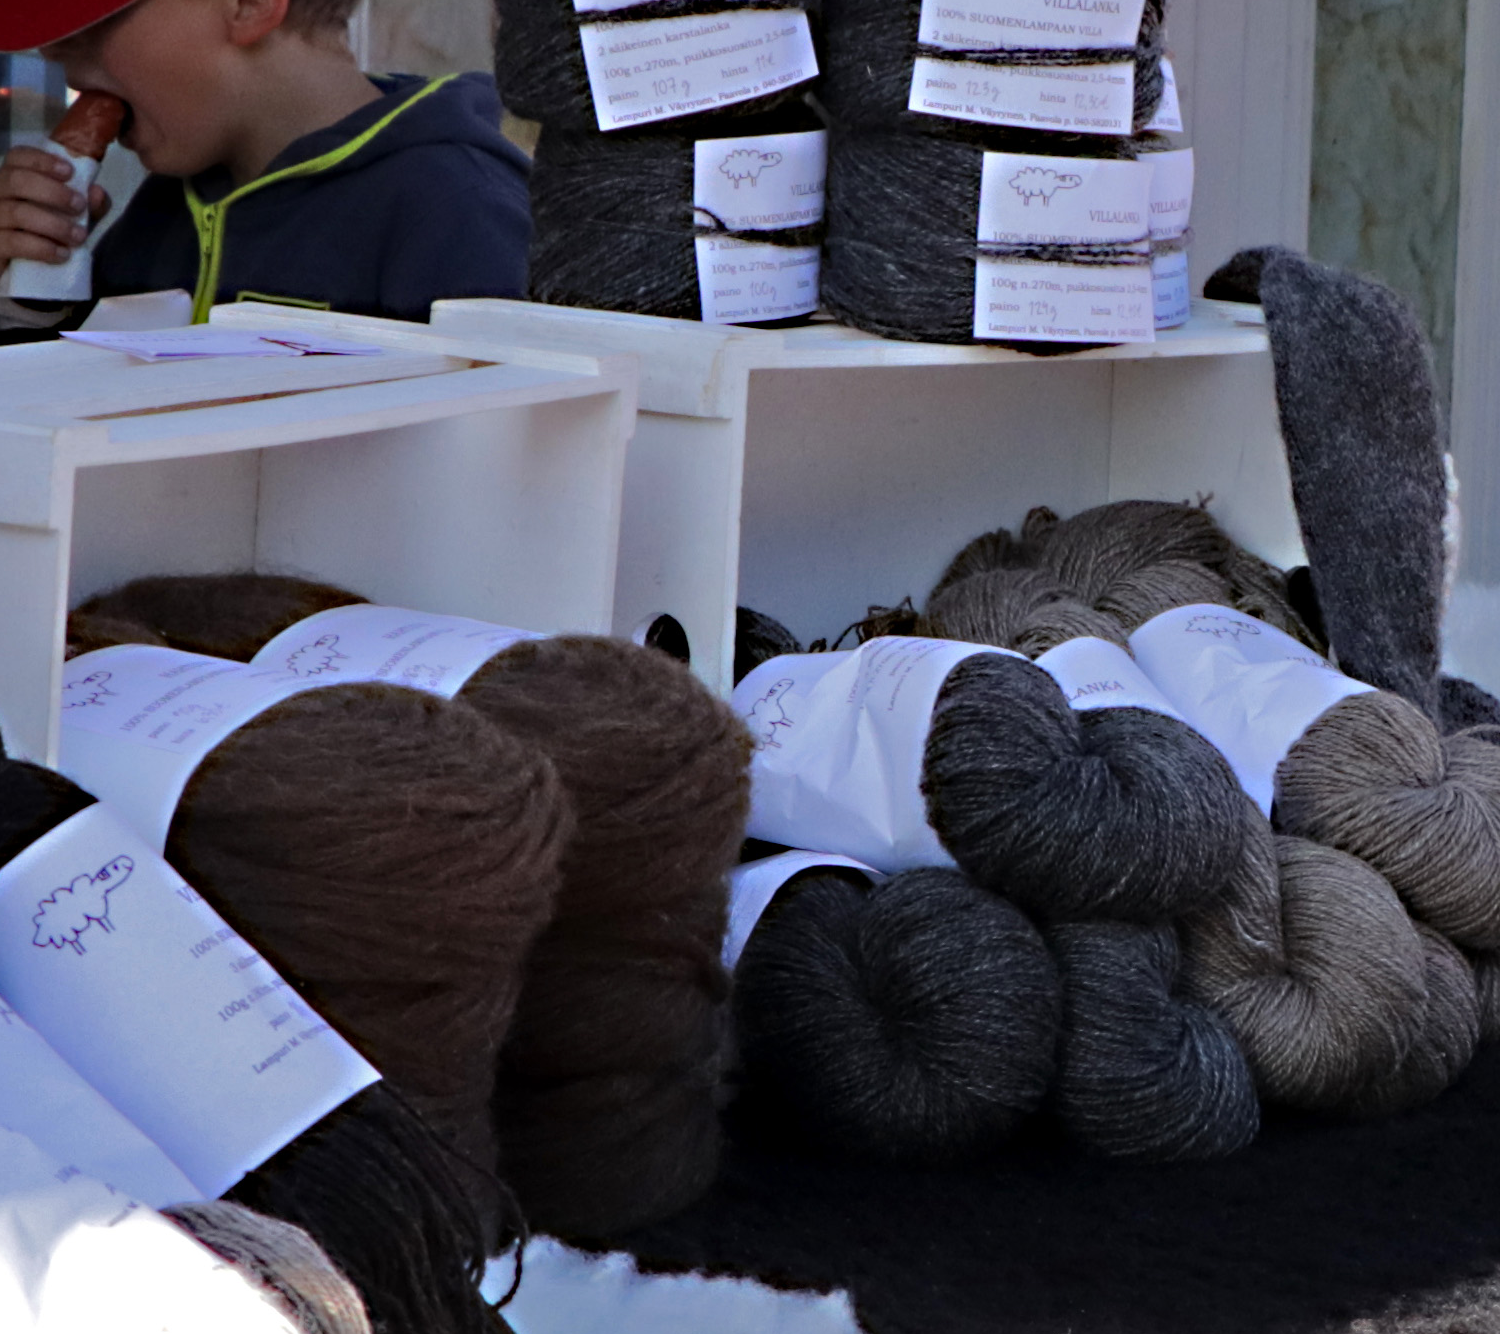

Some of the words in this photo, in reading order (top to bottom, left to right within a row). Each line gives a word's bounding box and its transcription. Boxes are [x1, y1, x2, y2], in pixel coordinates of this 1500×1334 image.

[936, 7, 967, 22] 100%
[969, 12, 1076, 35] SUOMENLAMPAAN
[1078, 25, 1103, 37] VILLA
[598, 46, 605, 57] 2
[608, 37, 662, 54] säikeinen
[665, 21, 731, 43] karstalanka
[932, 30, 940, 41] 2
[604, 66, 631, 81] 100g
[684, 38, 764, 65] puikkosuositus
[607, 89, 639, 105] paino
[720, 65, 749, 79] hinta
[925, 78, 957, 91] paino
[1039, 91, 1067, 104] hinta
[923, 97, 963, 114] Lampuri
[612, 108, 652, 123] Lampuri
[711, 264, 737, 276] 100g
[991, 277, 1018, 291] 100g
[713, 288, 742, 299] paino
[989, 300, 1020, 314] paino
[988, 322, 1026, 335] Lampuri
[1065, 680, 1125, 701] LANKA
[218, 997, 250, 1022] 100g
